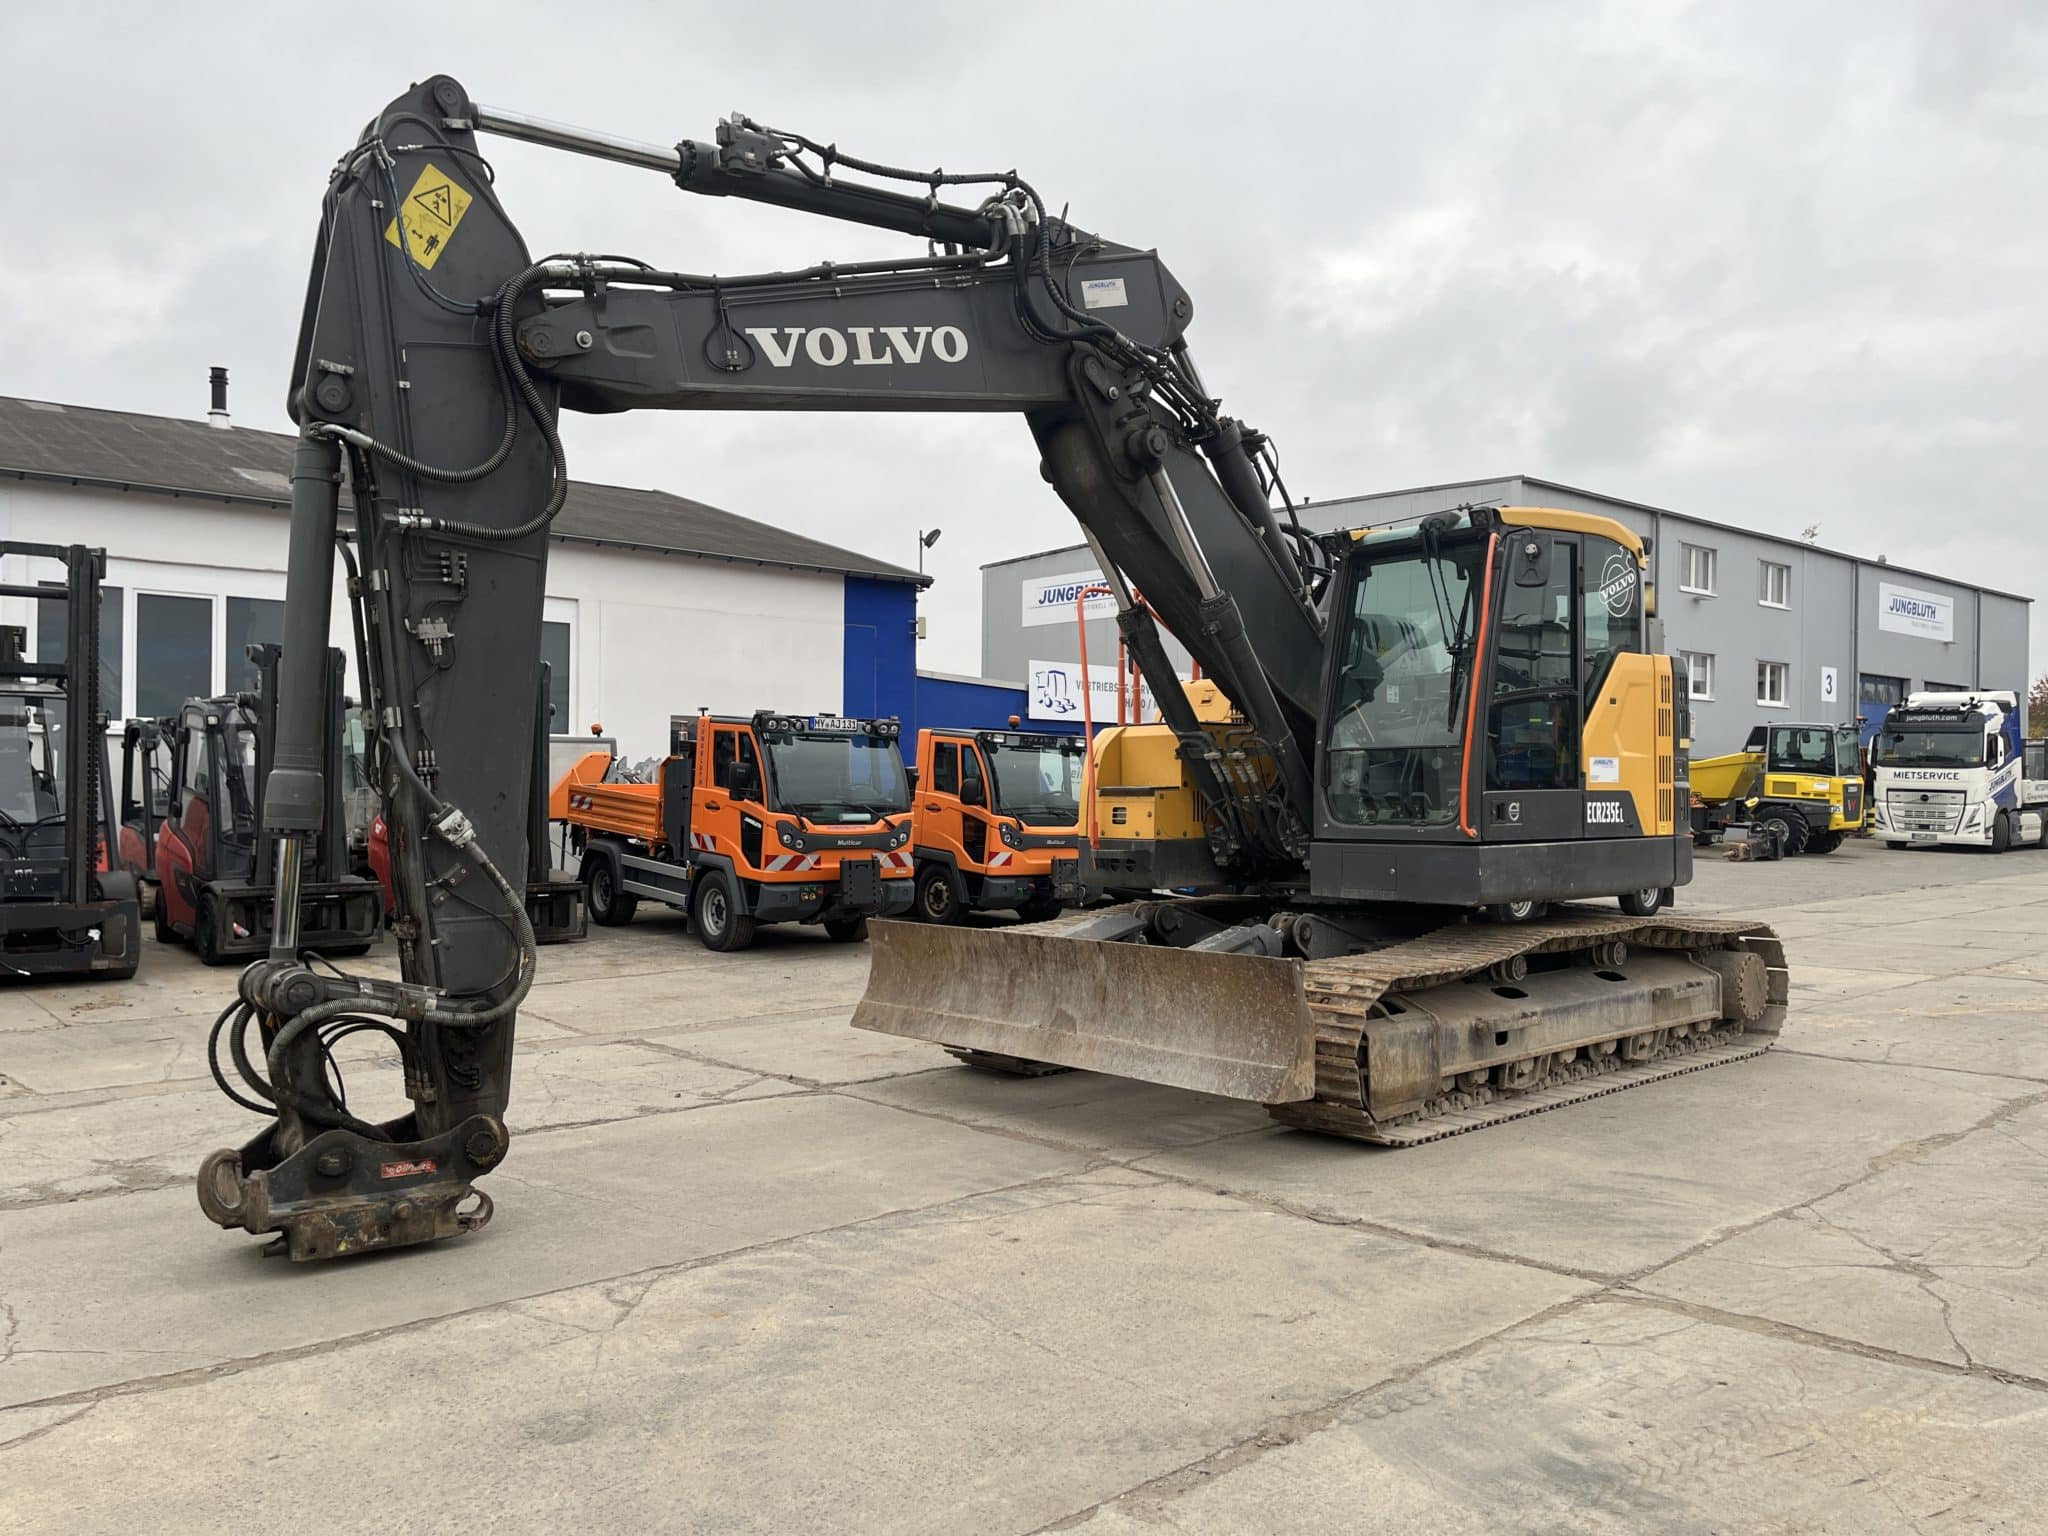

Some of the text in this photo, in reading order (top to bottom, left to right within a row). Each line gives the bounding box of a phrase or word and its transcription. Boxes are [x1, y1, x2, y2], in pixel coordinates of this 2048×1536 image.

[745, 326, 969, 367] VOLVO
[1038, 581, 1113, 605] JUNGBLUT
[1600, 572, 1635, 600] VOLVO
[1889, 597, 1937, 619] JUNGBLUTH
[1825, 674, 1834, 695] 3
[1905, 714, 1958, 722] jungbluth.com
[1893, 771, 1960, 781] MIETSERVICE
